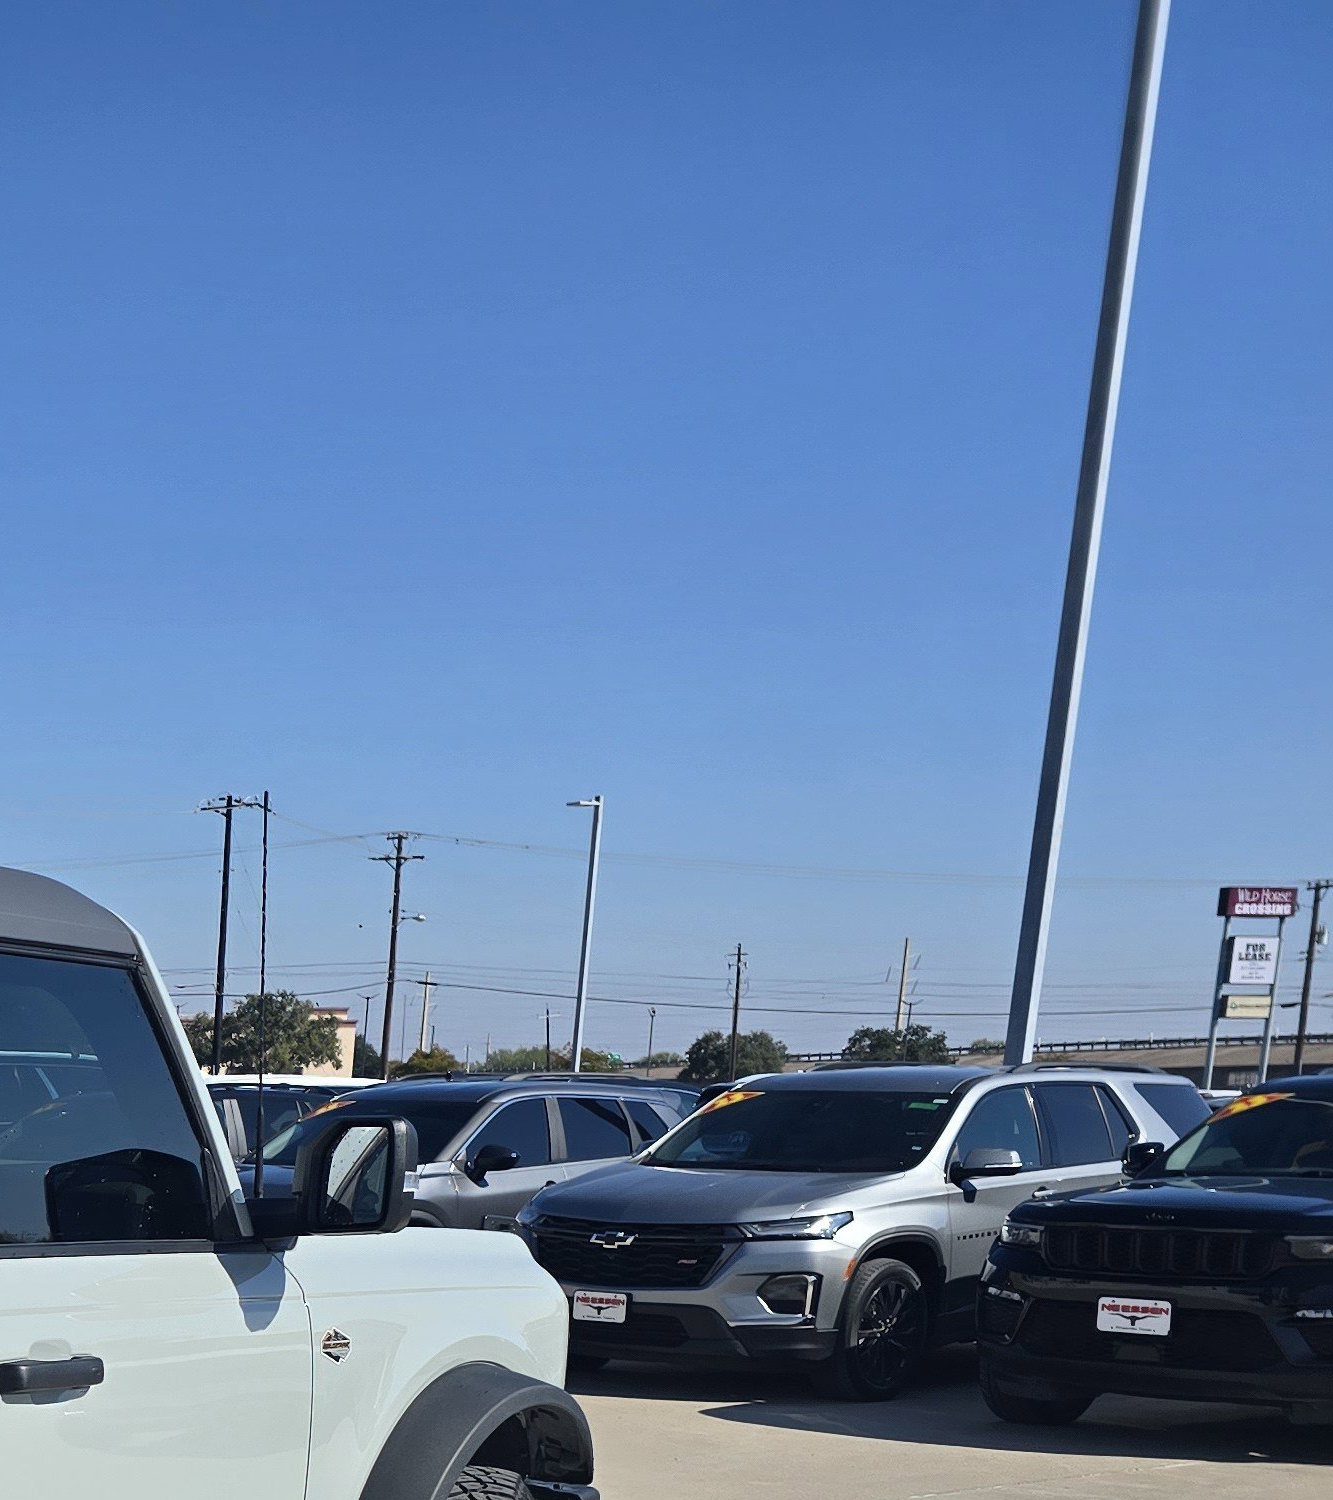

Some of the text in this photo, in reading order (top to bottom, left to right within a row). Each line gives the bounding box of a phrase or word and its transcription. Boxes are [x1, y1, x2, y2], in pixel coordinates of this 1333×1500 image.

[1235, 903, 1292, 915] CROSSING
[1246, 943, 1266, 951] FOR
[1238, 952, 1272, 961] LEASE
